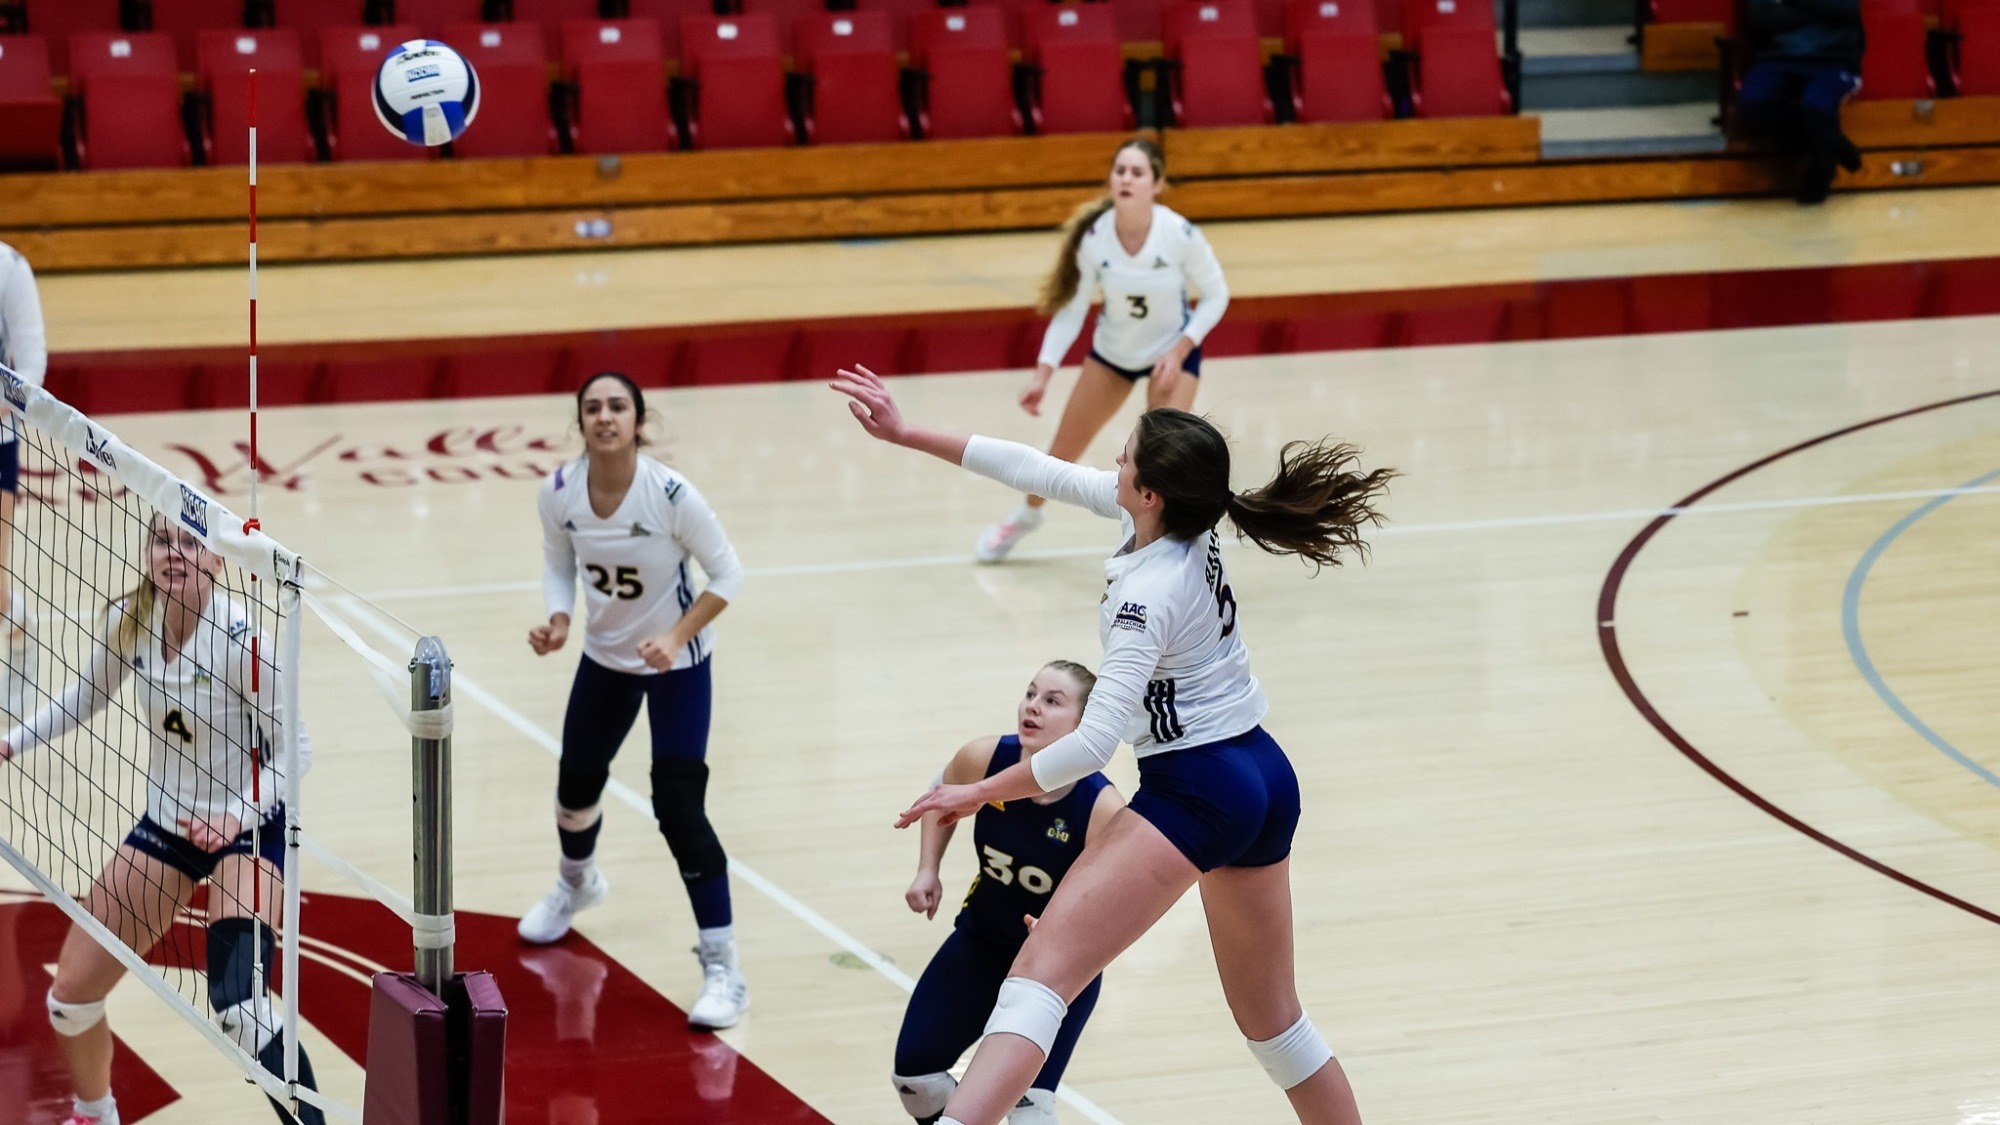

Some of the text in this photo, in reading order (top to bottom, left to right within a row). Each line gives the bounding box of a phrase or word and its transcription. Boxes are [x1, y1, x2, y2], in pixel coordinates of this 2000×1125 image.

[1126, 295, 1149, 320] 3
[361, 462, 556, 486] COU
[181, 485, 207, 530] NCAA
[585, 563, 644, 600] 25
[1120, 601, 1147, 616] AAC
[163, 708, 193, 744] 4
[983, 844, 1054, 895] 30
